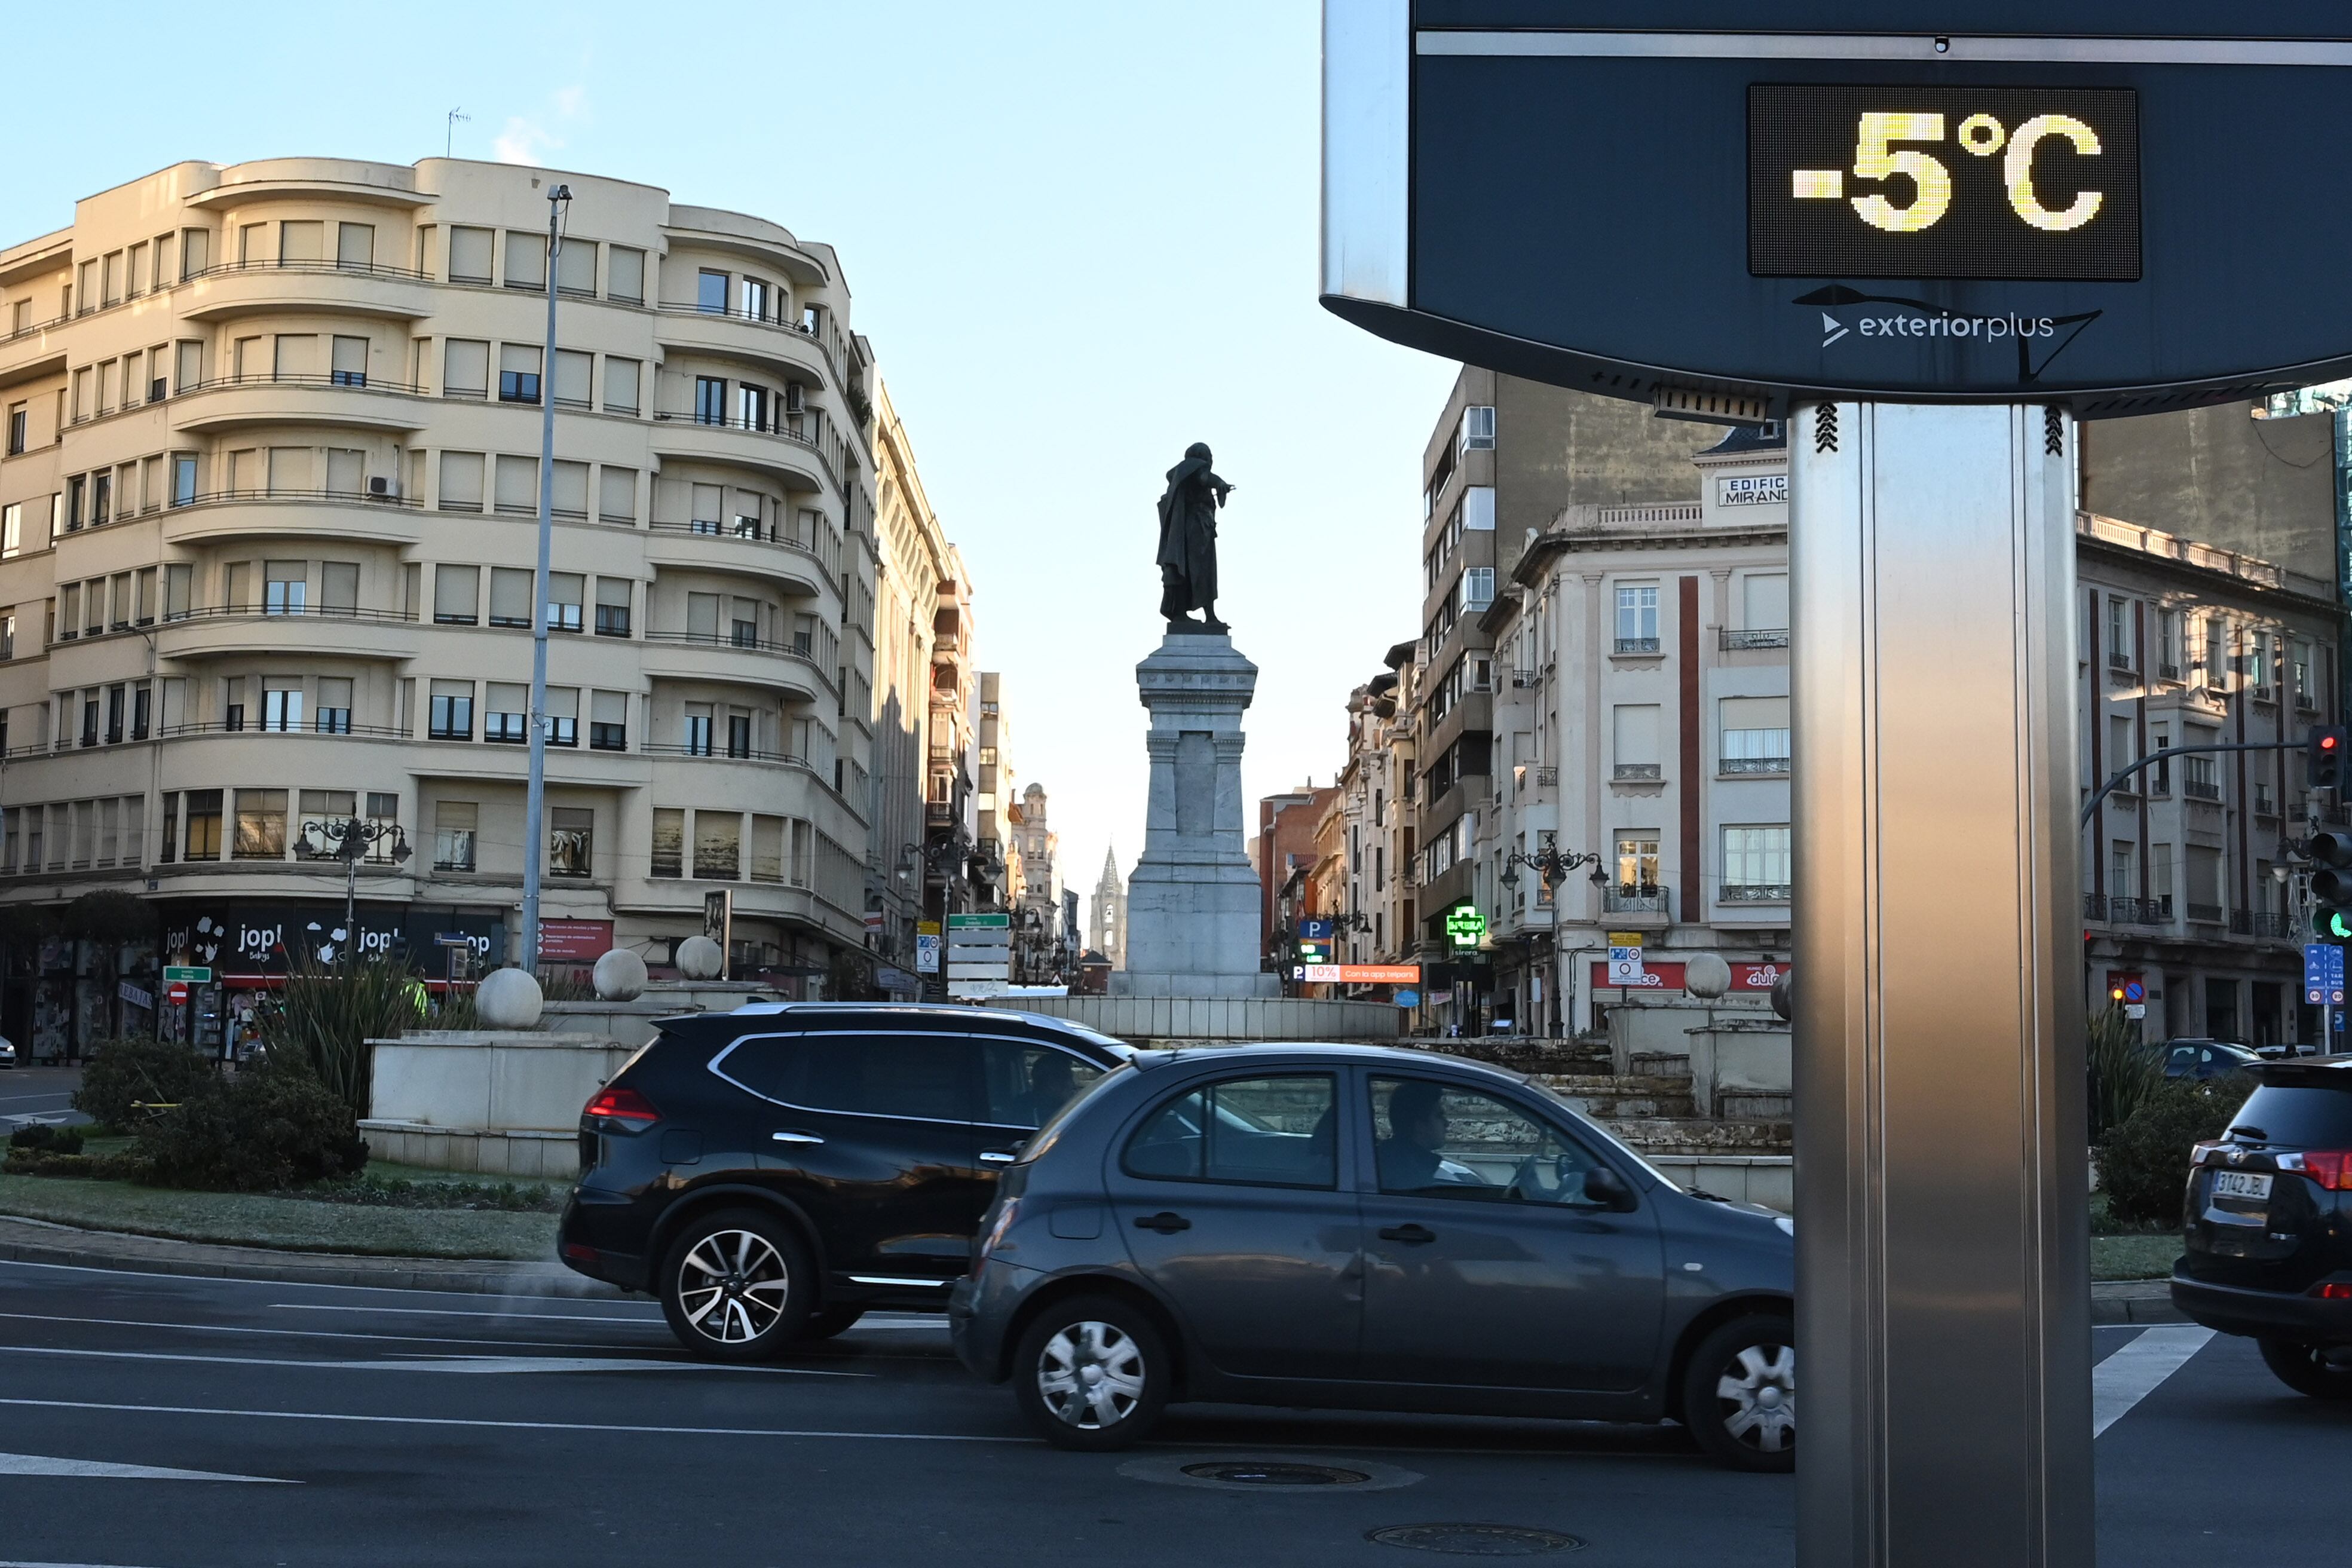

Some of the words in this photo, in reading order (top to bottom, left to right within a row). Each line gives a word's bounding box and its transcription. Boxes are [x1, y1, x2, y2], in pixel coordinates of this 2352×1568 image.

[1792, 112, 2102, 232] -5°C
[1858, 310, 2054, 342] exteriorplus
[238, 924, 284, 953] jop!
[1309, 921, 1321, 938] P
[1293, 966, 1303, 979] P
[1311, 966, 1336, 978] 10%
[2218, 1173, 2246, 1193] 3142
